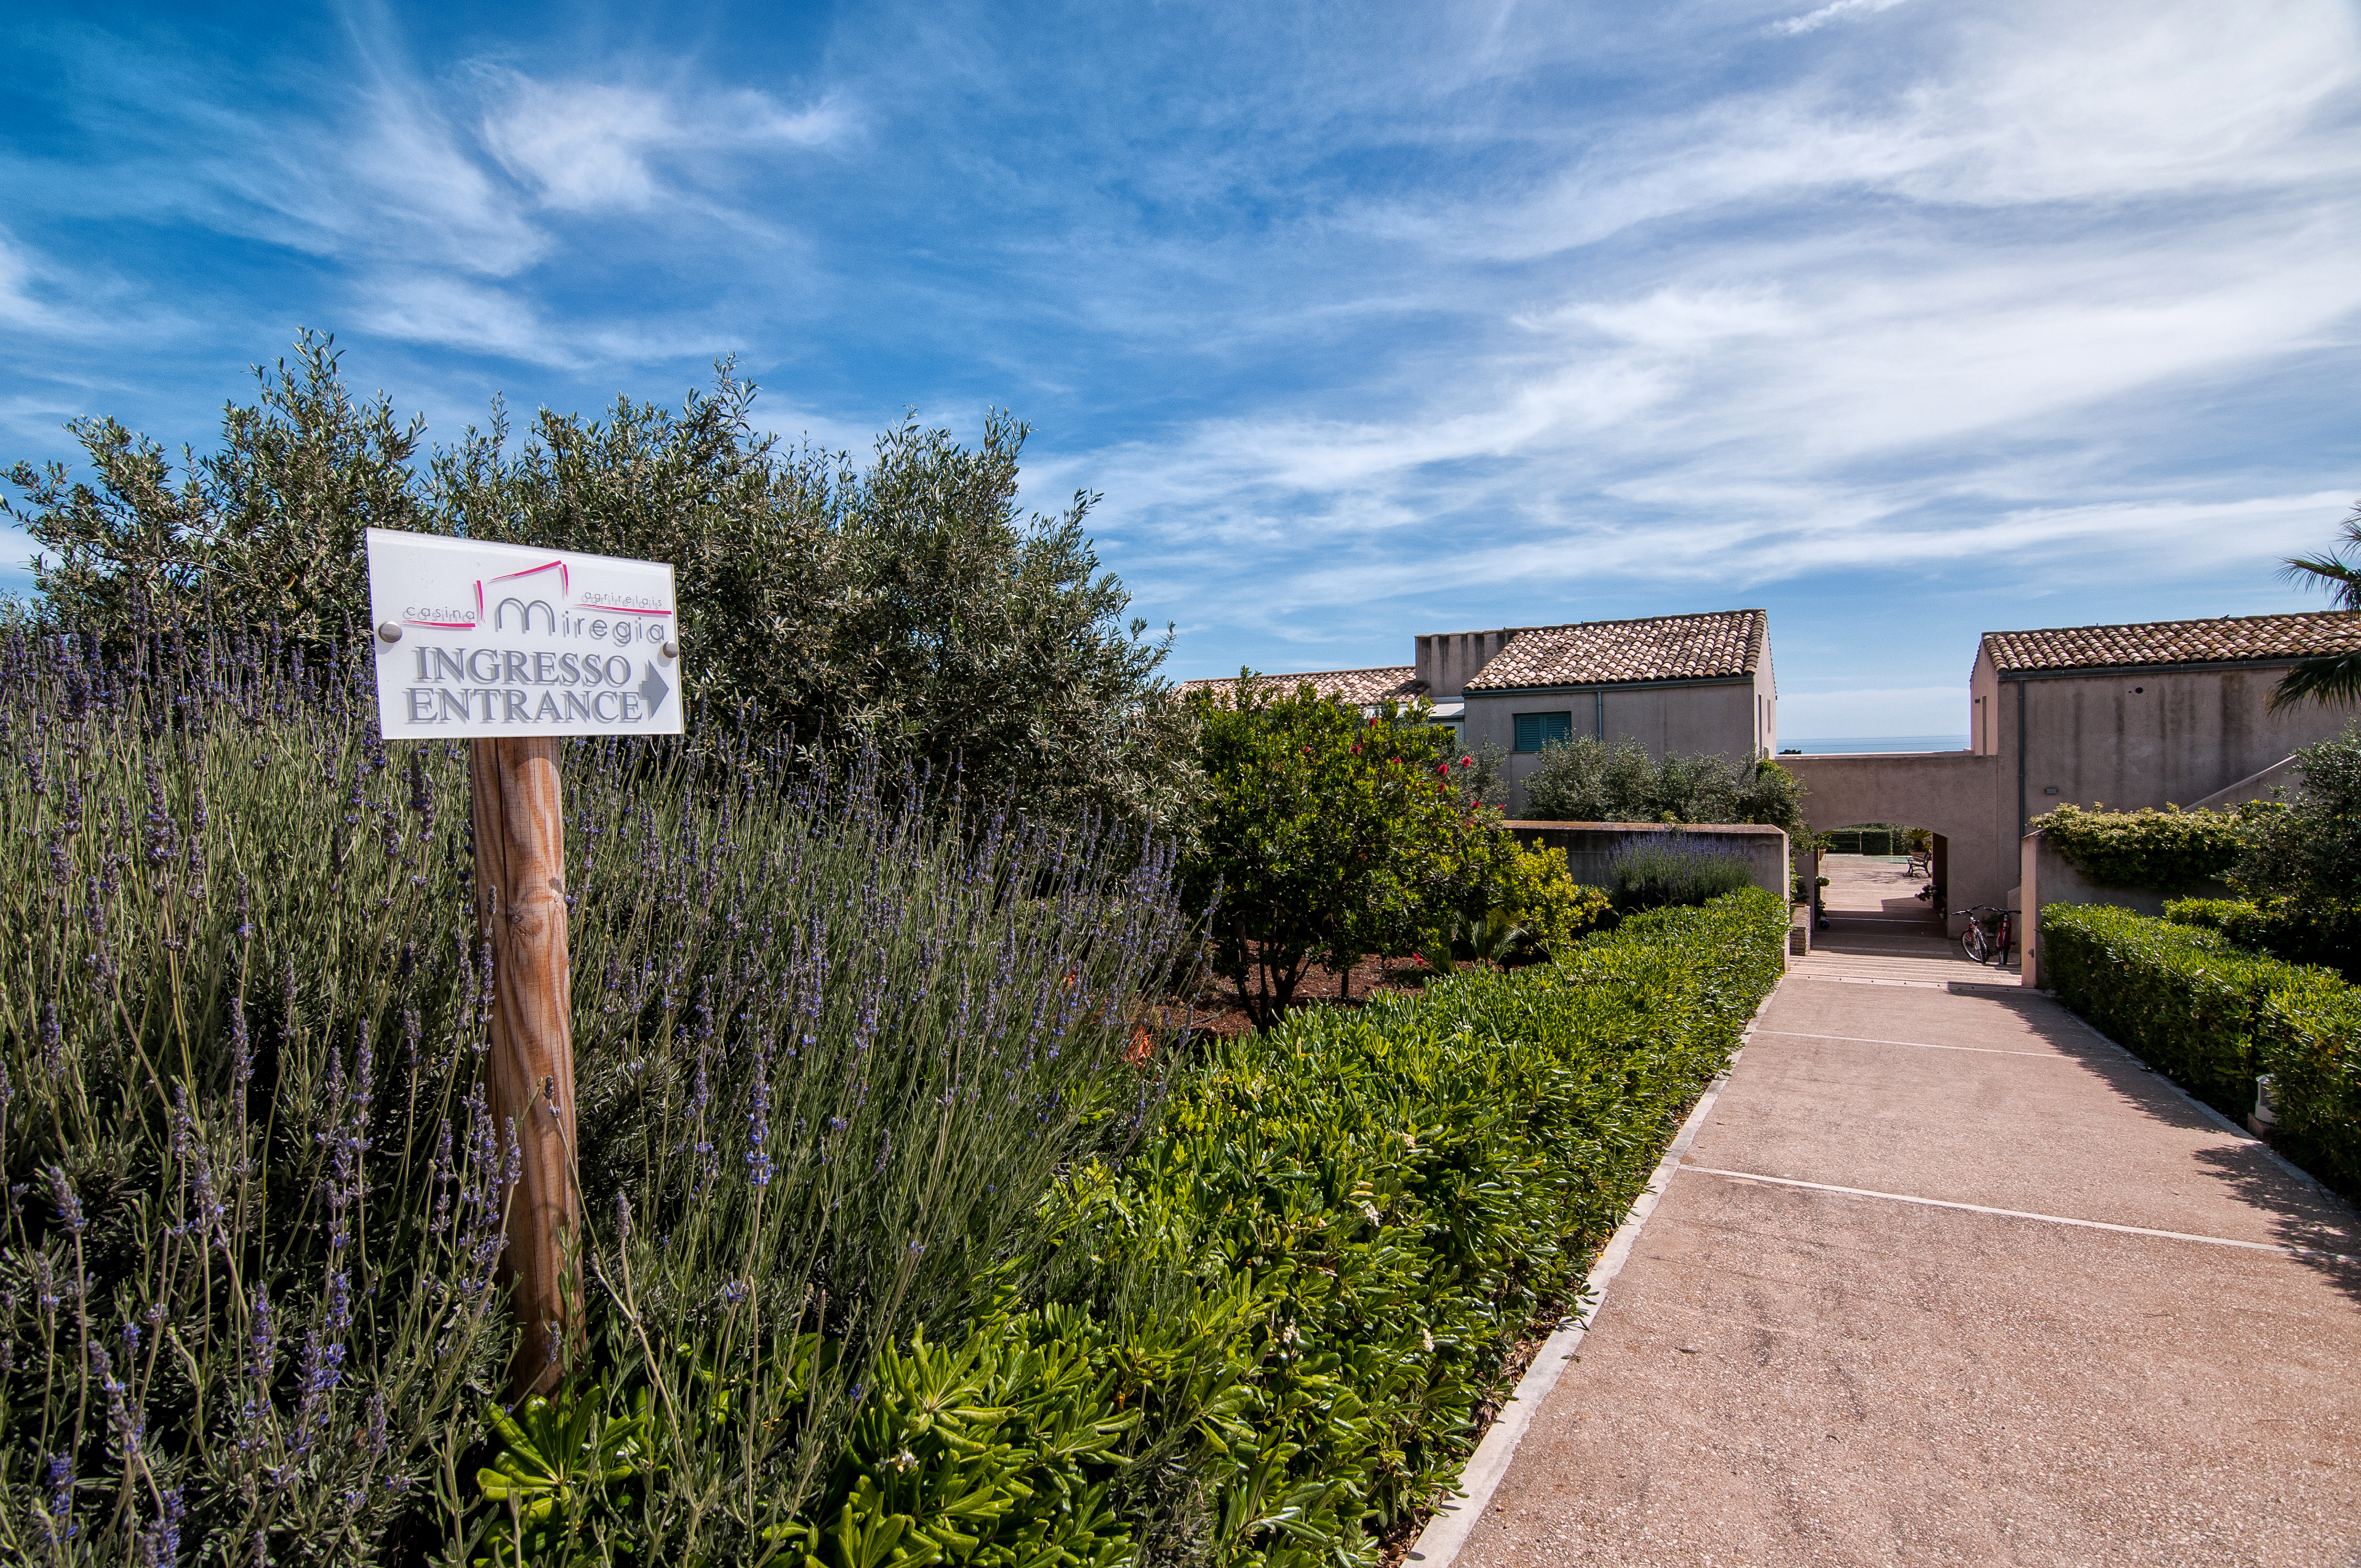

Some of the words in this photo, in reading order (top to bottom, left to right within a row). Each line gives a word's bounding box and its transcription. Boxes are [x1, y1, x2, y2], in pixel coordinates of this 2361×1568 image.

[585, 591, 662, 607] agrirelais
[407, 606, 475, 620] casina
[415, 646, 631, 684] INGRESSO
[406, 688, 643, 721] ENTRANCE
